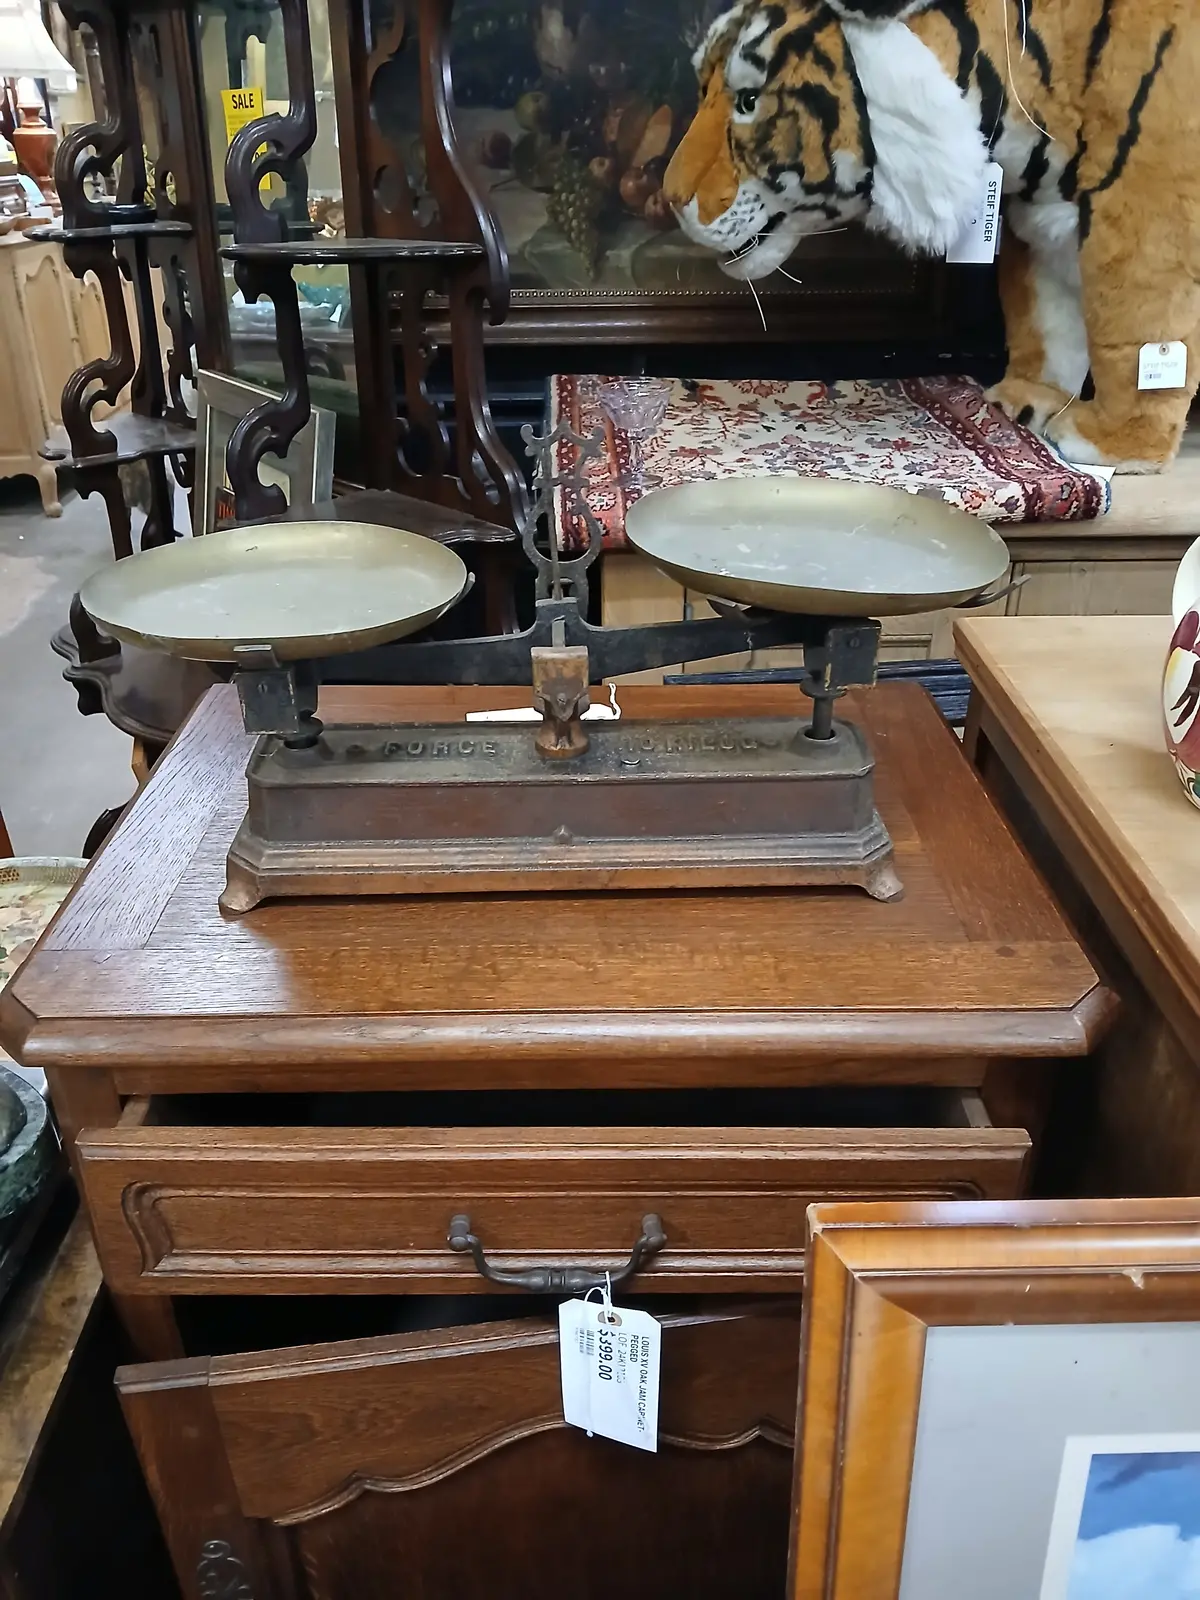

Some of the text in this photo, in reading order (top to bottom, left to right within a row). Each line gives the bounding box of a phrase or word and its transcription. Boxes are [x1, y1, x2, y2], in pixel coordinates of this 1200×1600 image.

[231, 93, 254, 109] SALE
[983, 181, 997, 242] STEIF TIGER
[384, 739, 496, 757] FORCE
[618, 1332, 628, 1349] LOF
[629, 1334, 639, 1363] PEGGED
[641, 1336, 650, 1360] LOUIS
[597, 1328, 614, 1381] $399.00
[640, 1360, 649, 1369] XV
[639, 1369, 648, 1384] OAK
[638, 1384, 647, 1402] JAM
